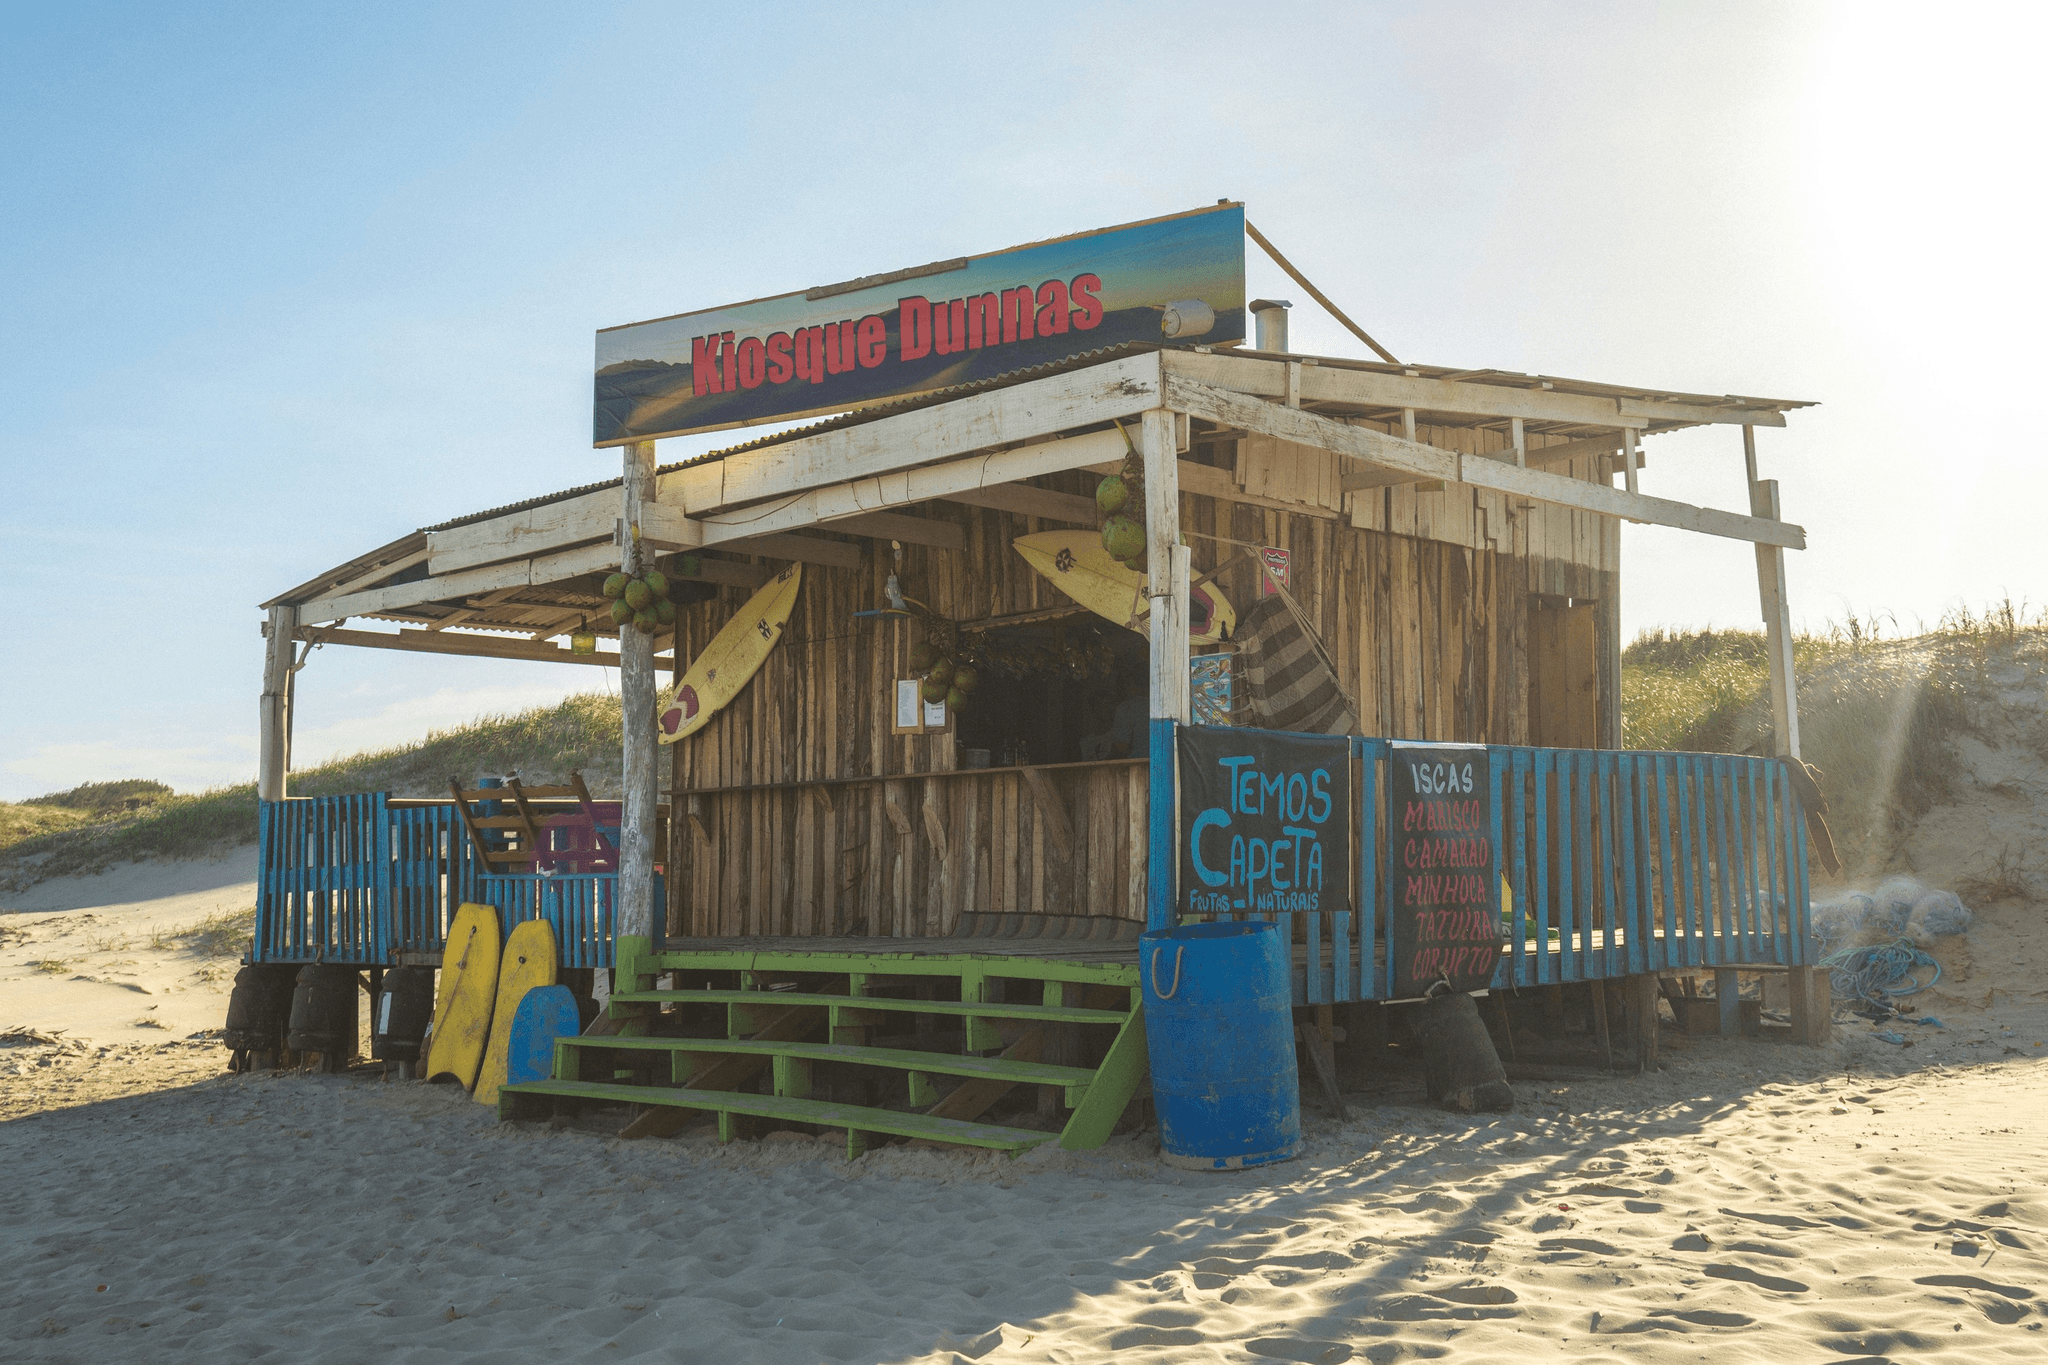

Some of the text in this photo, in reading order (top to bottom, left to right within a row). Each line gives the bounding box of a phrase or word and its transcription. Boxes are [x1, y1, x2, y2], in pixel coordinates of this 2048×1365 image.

[692, 273, 1104, 398] Kiosque Dunnas
[1218, 755, 1332, 824] TEMOS
[1411, 763, 1474, 795] ISCAS
[1404, 800, 1480, 832] MARISCO
[1190, 808, 1323, 907] CAPETA
[1190, 888, 1231, 912] FRUTAS
[1257, 890, 1319, 912] NATURAIS
[1405, 873, 1486, 906] MINHOCA
